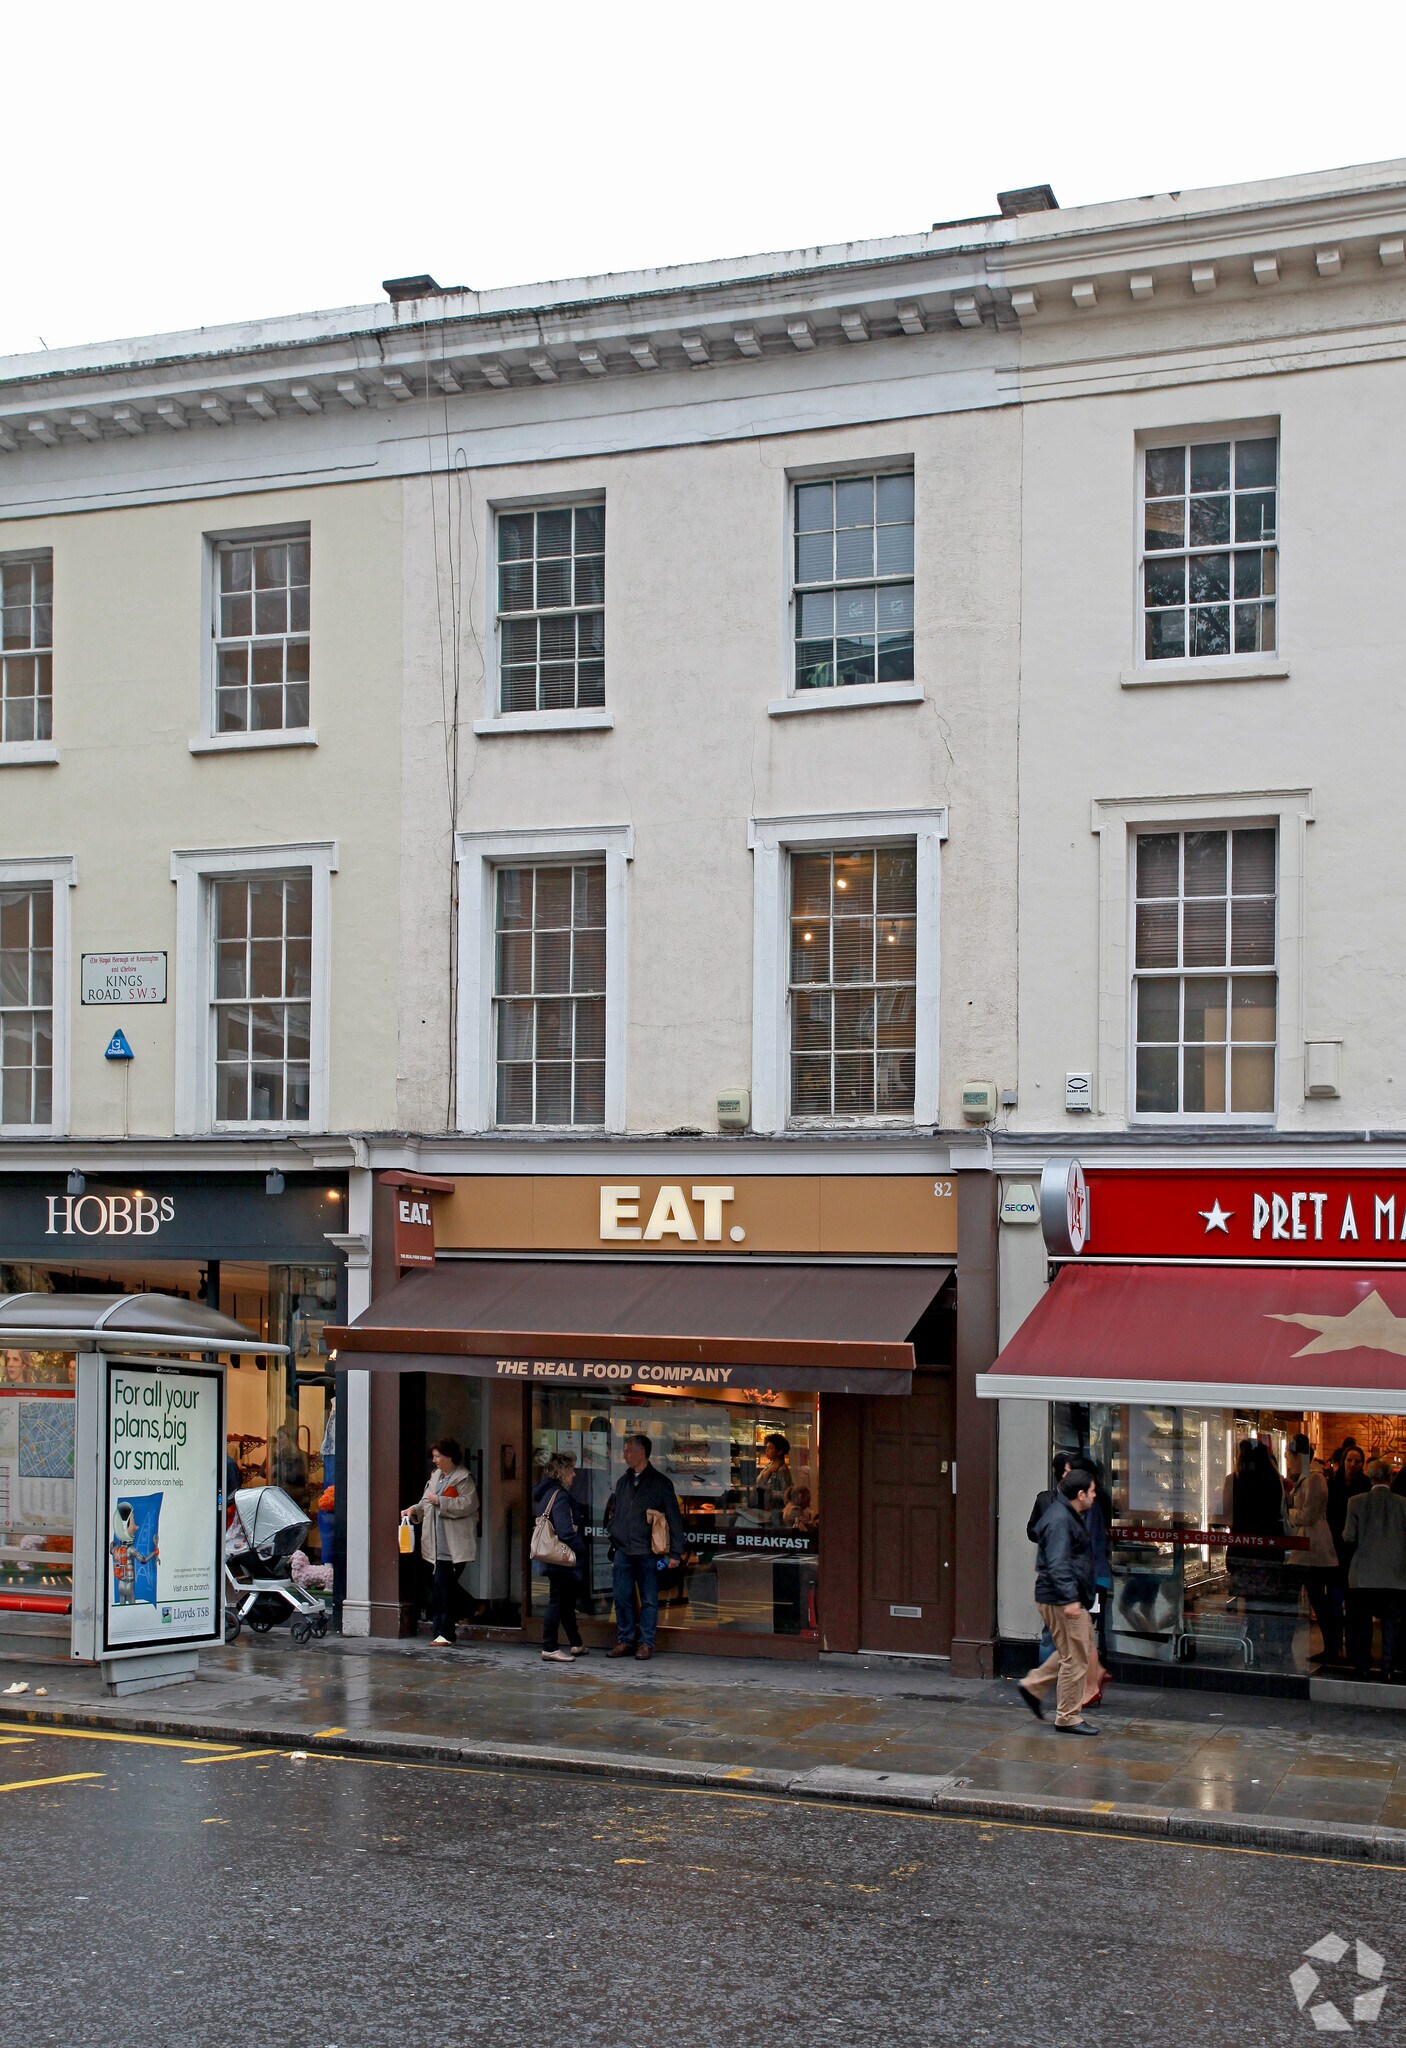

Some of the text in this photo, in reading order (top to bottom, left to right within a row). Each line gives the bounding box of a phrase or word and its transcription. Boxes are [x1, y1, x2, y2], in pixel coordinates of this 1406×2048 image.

[106, 975, 143, 987] KINGS
[933, 1181, 952, 1197] 82
[45, 1195, 175, 1236] HOBBS
[399, 1200, 432, 1226] EAT.
[599, 1185, 746, 1242] EAT.
[1004, 1204, 1035, 1212] SECOM
[1252, 1192, 1328, 1240] PRET
[1339, 1193, 1359, 1240] A
[496, 1361, 733, 1382] THE REAL FOOD COMPANY
[115, 1379, 200, 1414] For all your
[114, 1410, 187, 1446] plans, big
[113, 1444, 180, 1471] or small.
[112, 1477, 123, 1486] Our
[123, 1478, 147, 1487] personal
[147, 1478, 162, 1486] loans
[736, 1535, 810, 1549] BREAKFAST
[1143, 1531, 1179, 1540] SOUPS
[1194, 1533, 1264, 1546] CROISSANTS
[173, 1607, 209, 1621] Lloyds TSB
